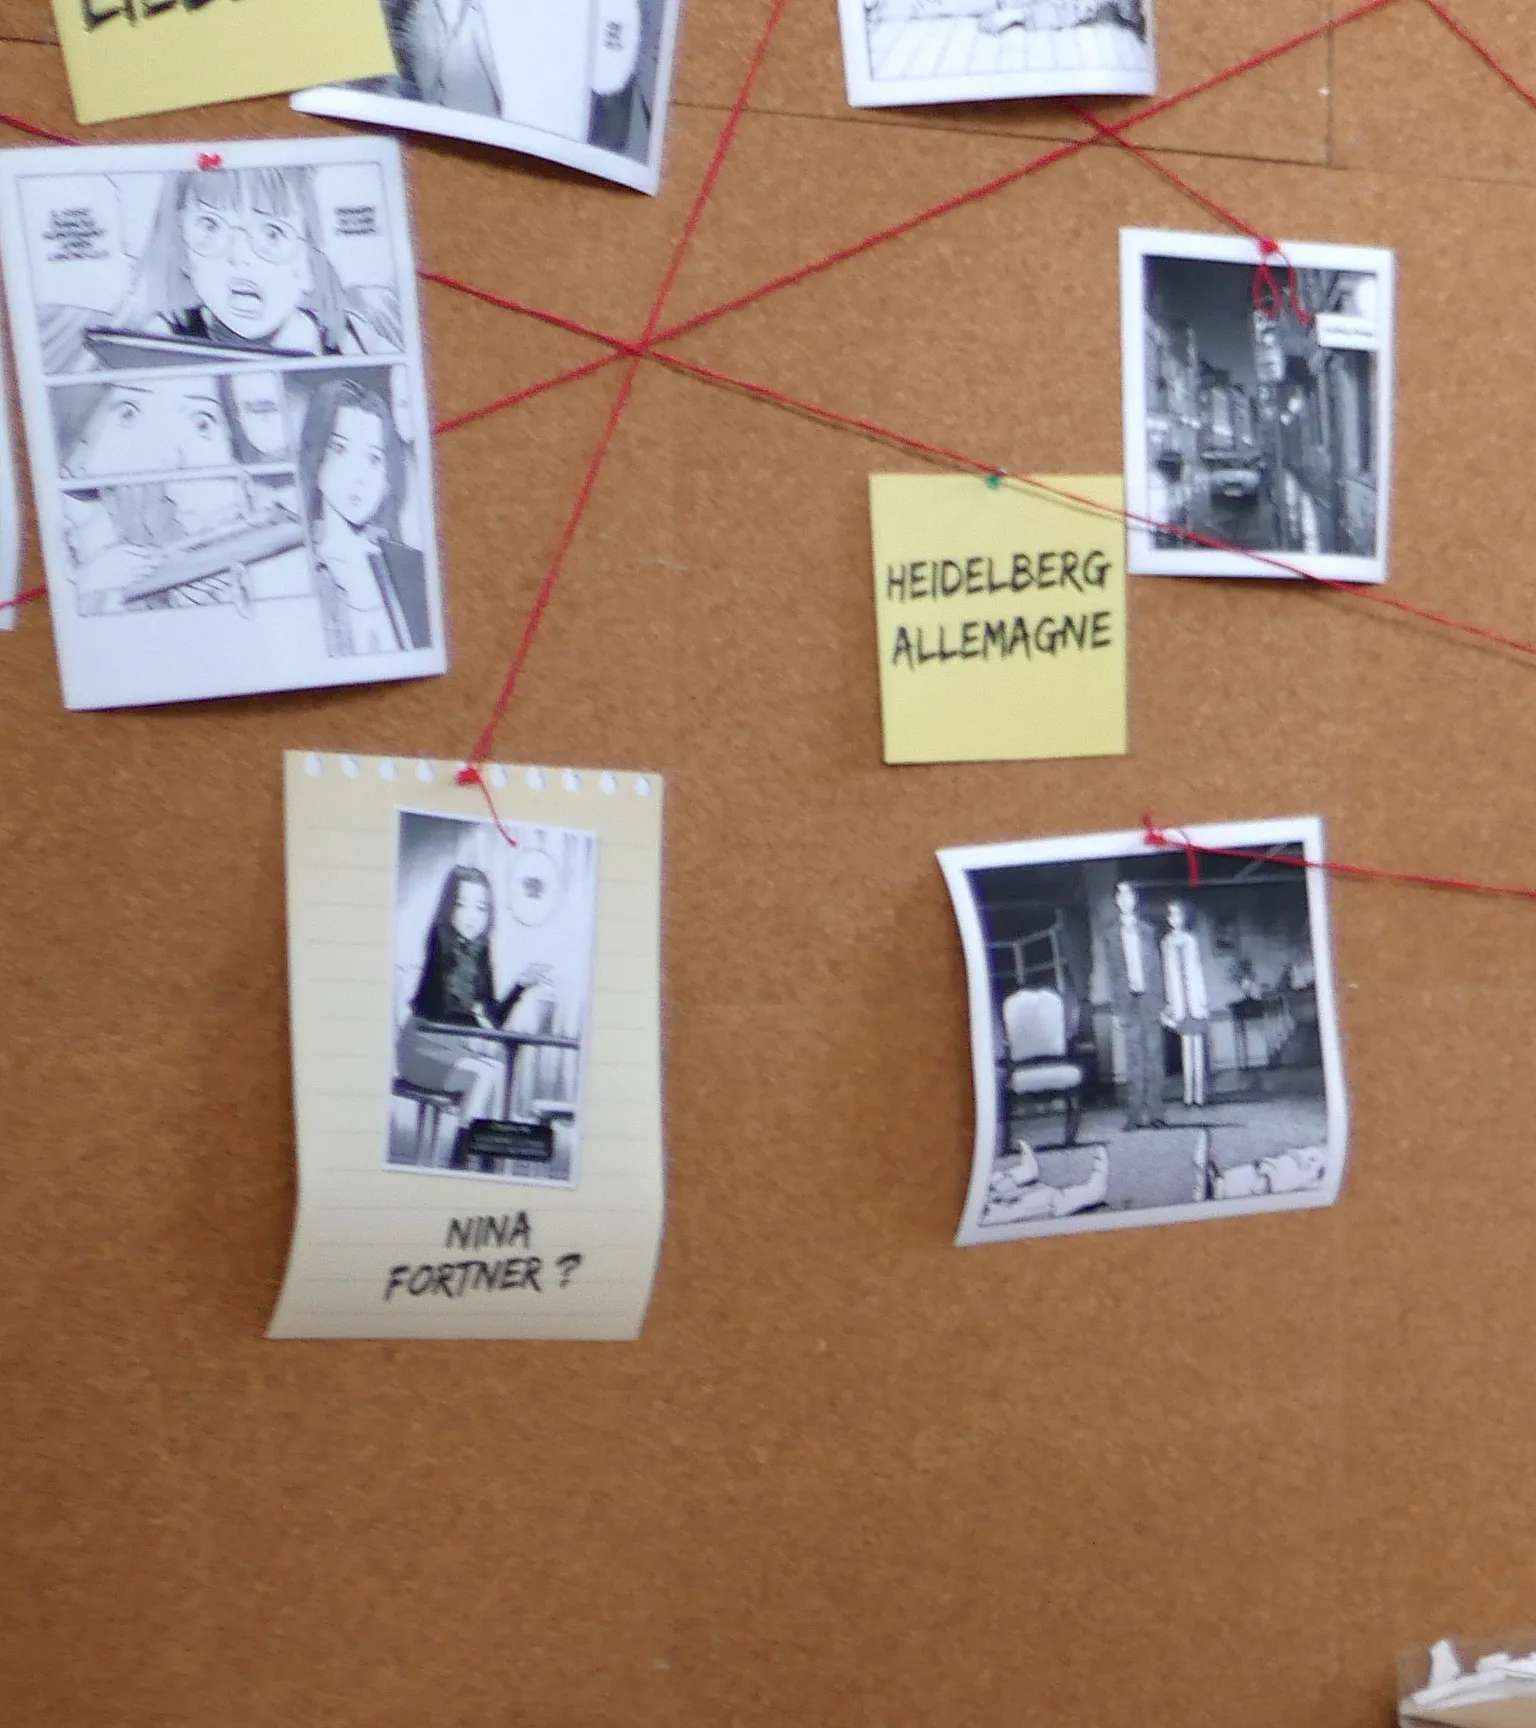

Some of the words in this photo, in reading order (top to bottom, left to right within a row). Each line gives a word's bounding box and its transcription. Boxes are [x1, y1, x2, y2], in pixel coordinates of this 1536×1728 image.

[885, 549, 1112, 604] HEIDELBERG
[892, 610, 1111, 671] ALLEMAGNE
[443, 1209, 534, 1252] NINA
[384, 1256, 542, 1303] FORTNER
[554, 1250, 584, 1289] ?
